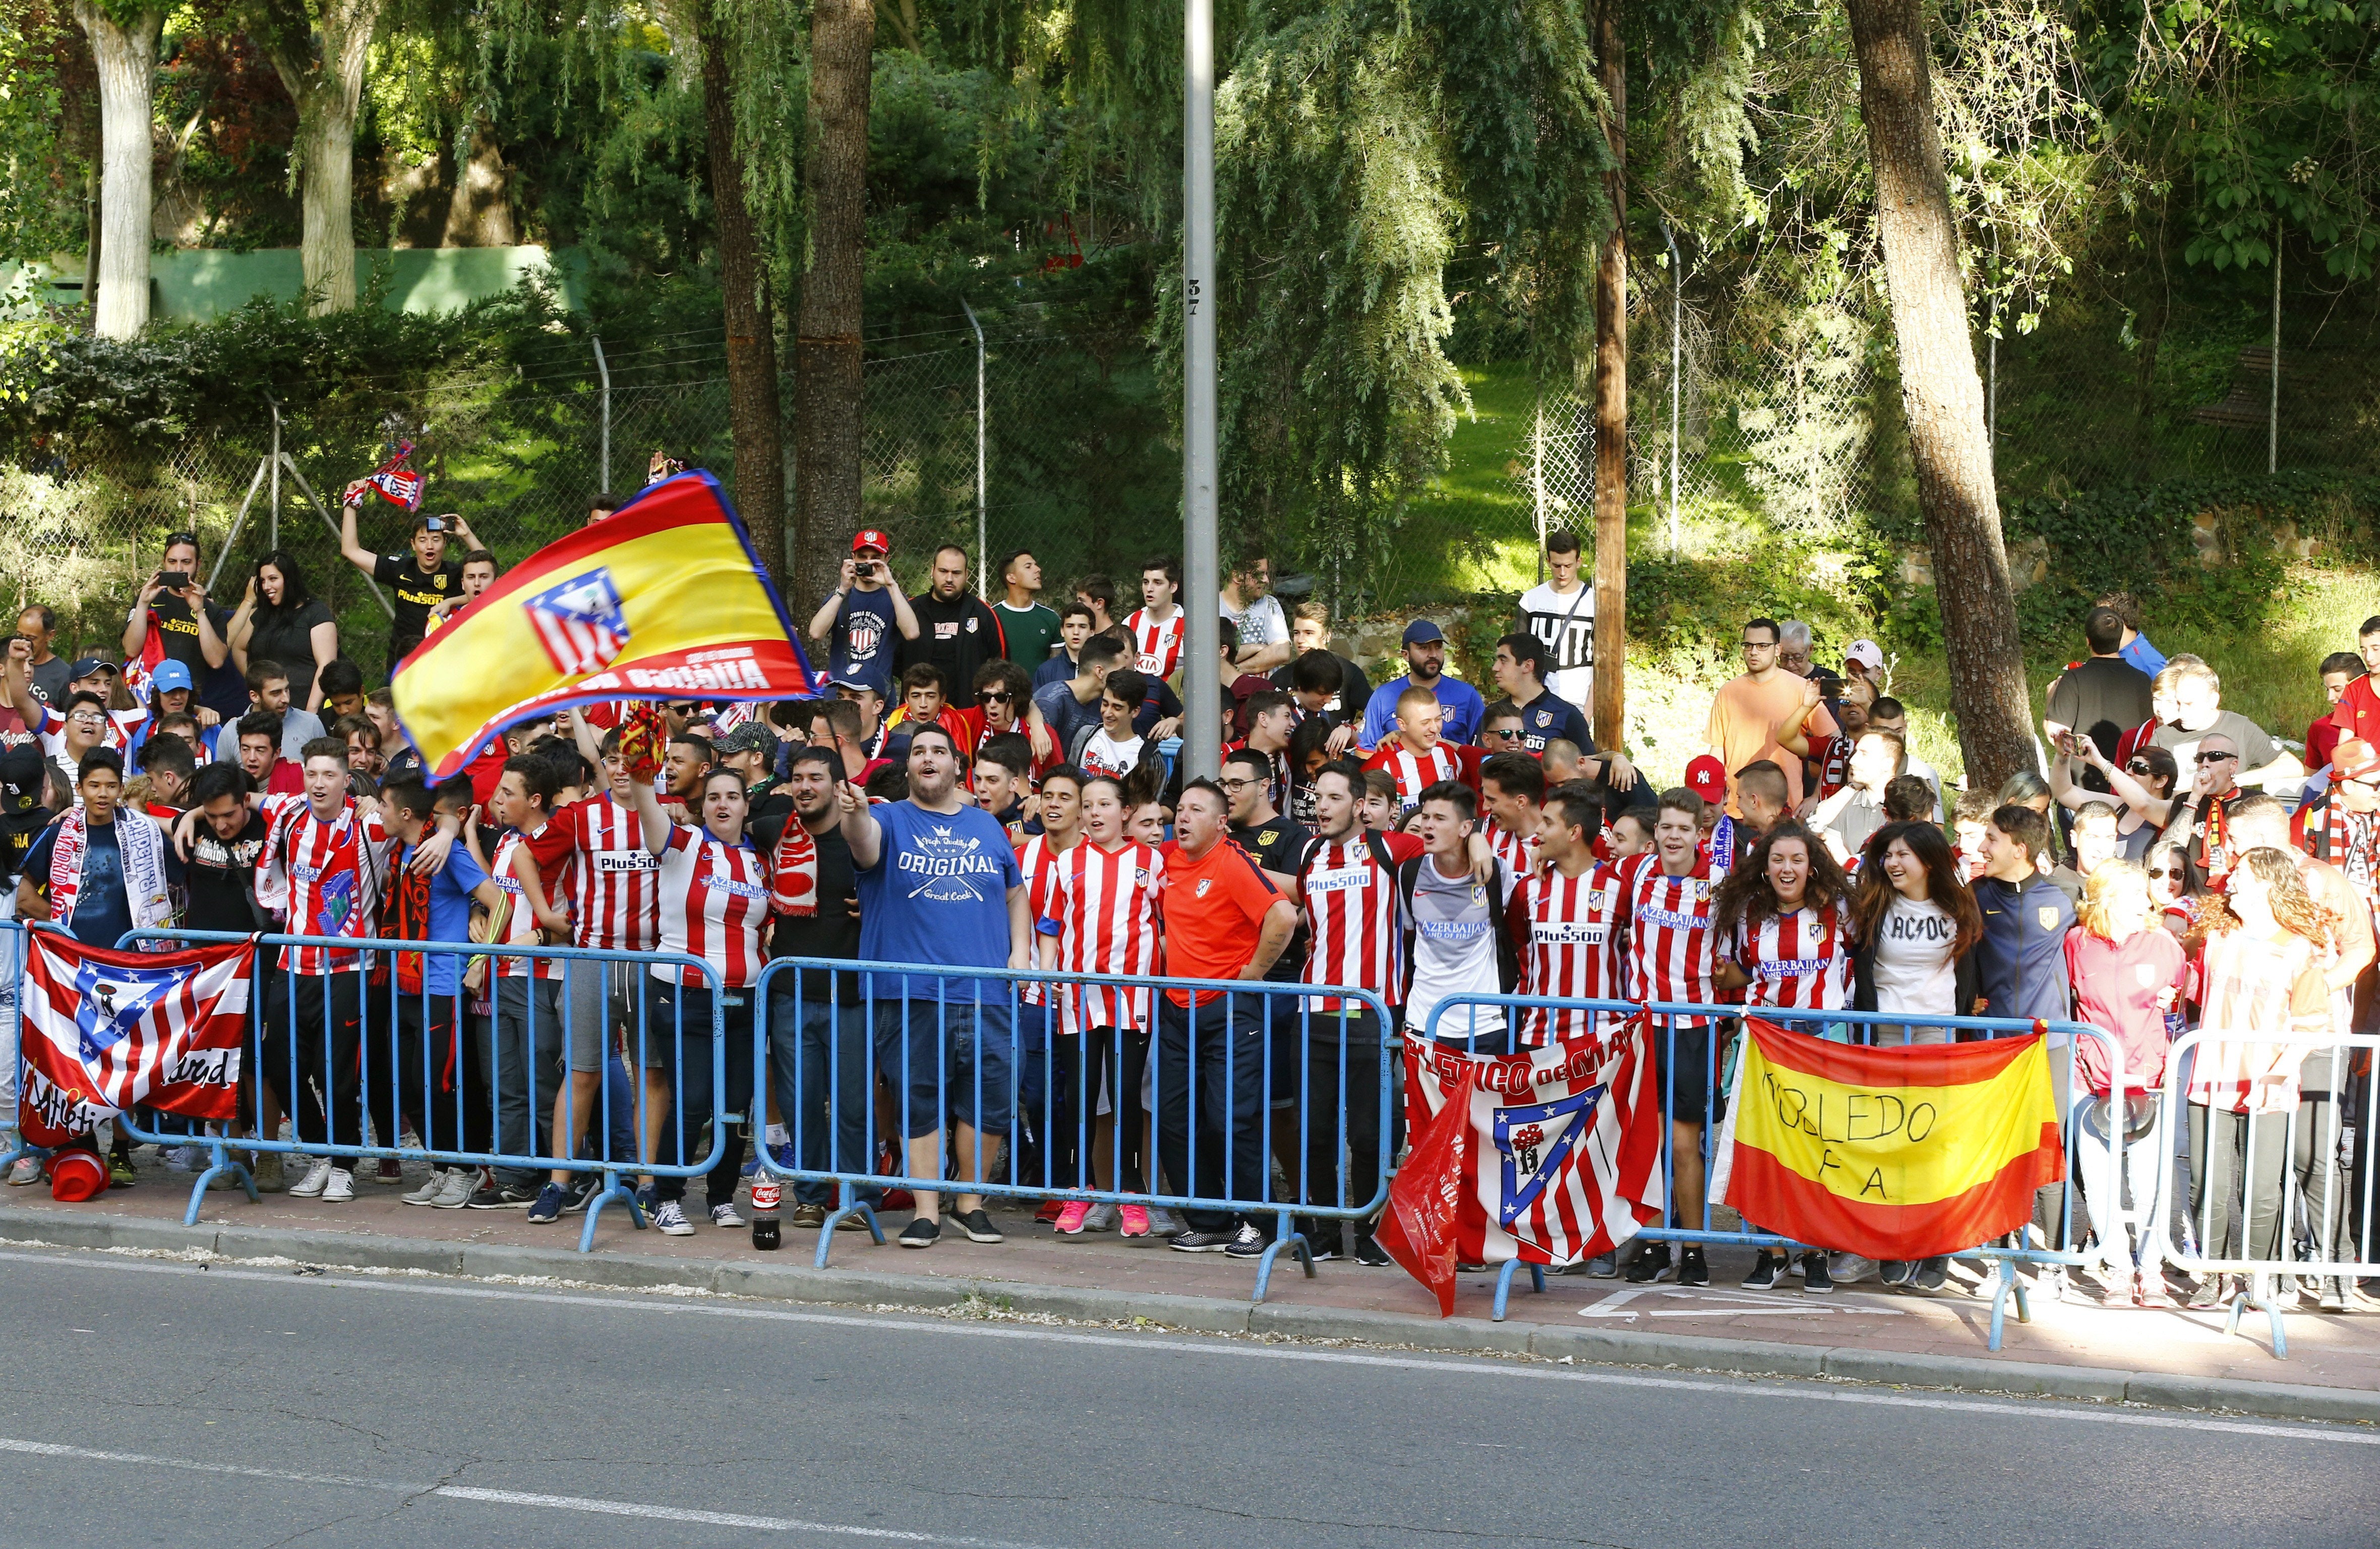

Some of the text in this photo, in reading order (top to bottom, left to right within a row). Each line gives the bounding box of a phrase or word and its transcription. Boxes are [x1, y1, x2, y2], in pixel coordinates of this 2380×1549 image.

[1136, 659, 1157, 671] KIA
[28, 682, 48, 701] ICO
[1697, 770, 1710, 784] NY
[921, 837, 968, 849] High Quality
[601, 858, 660, 869] Plus50
[898, 851, 999, 876] ORIGINAL
[493, 873, 522, 889] AZERBA
[712, 884, 731, 892] LAND
[1307, 874, 1368, 893] Plus500
[923, 889, 974, 901] Great Cook
[1640, 903, 1710, 929] AZERBAIJAN
[1641, 915, 1659, 925] LAND
[1421, 919, 1489, 937] AZERBAIJAN
[1535, 930, 1603, 942] Plus500
[1760, 958, 1830, 973] AZERBAIJAN
